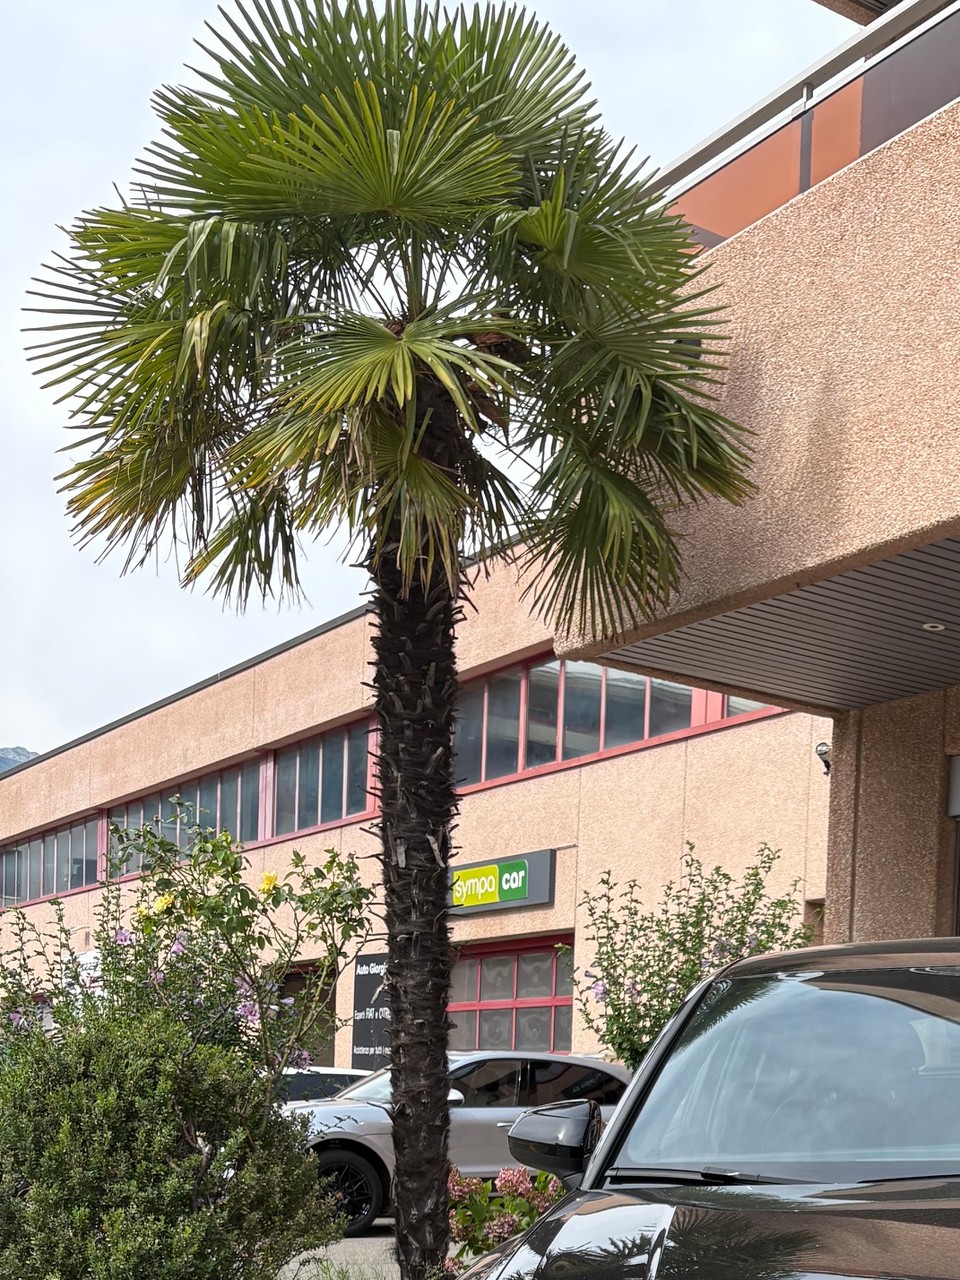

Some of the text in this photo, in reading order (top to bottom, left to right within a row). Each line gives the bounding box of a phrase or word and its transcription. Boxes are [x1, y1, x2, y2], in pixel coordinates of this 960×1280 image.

[455, 870, 525, 902] sympa car
[356, 962, 387, 976] Auto Giorgi
[366, 1007, 375, 1019] FIAT
